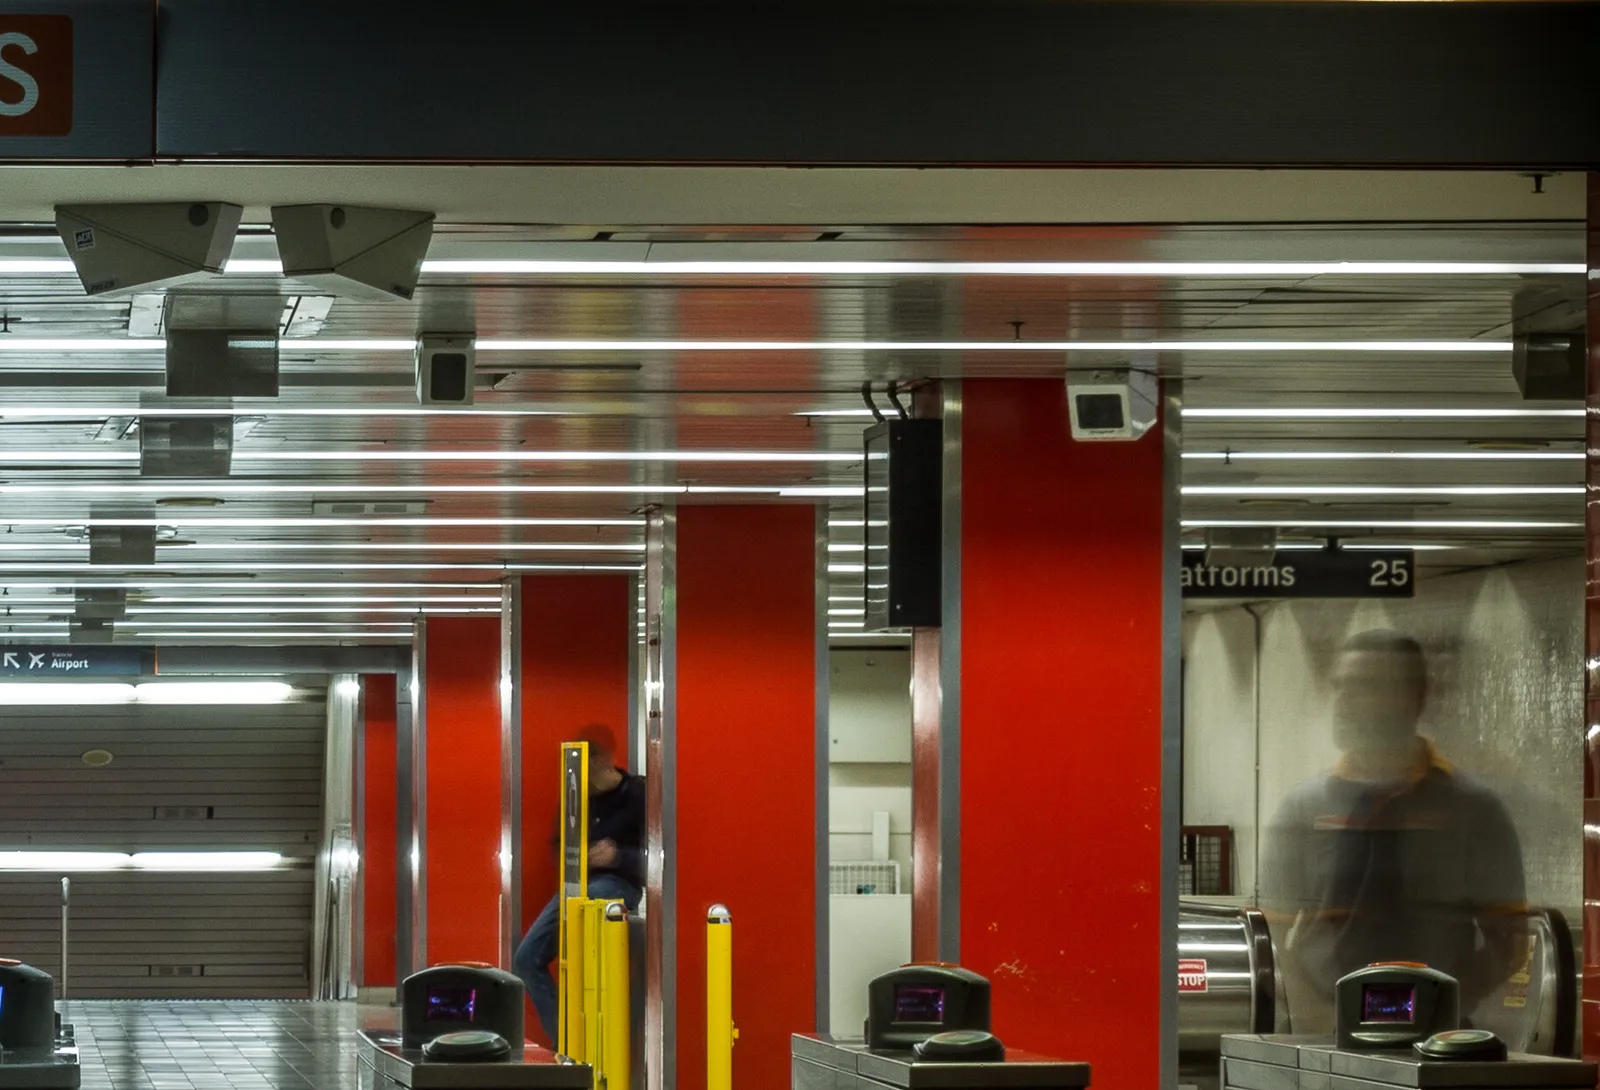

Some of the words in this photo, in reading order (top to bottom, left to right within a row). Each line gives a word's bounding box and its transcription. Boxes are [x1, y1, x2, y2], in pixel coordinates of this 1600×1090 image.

[1179, 562, 1296, 587] atforms
[1369, 560, 1409, 587] 25
[51, 658, 89, 671] Airport
